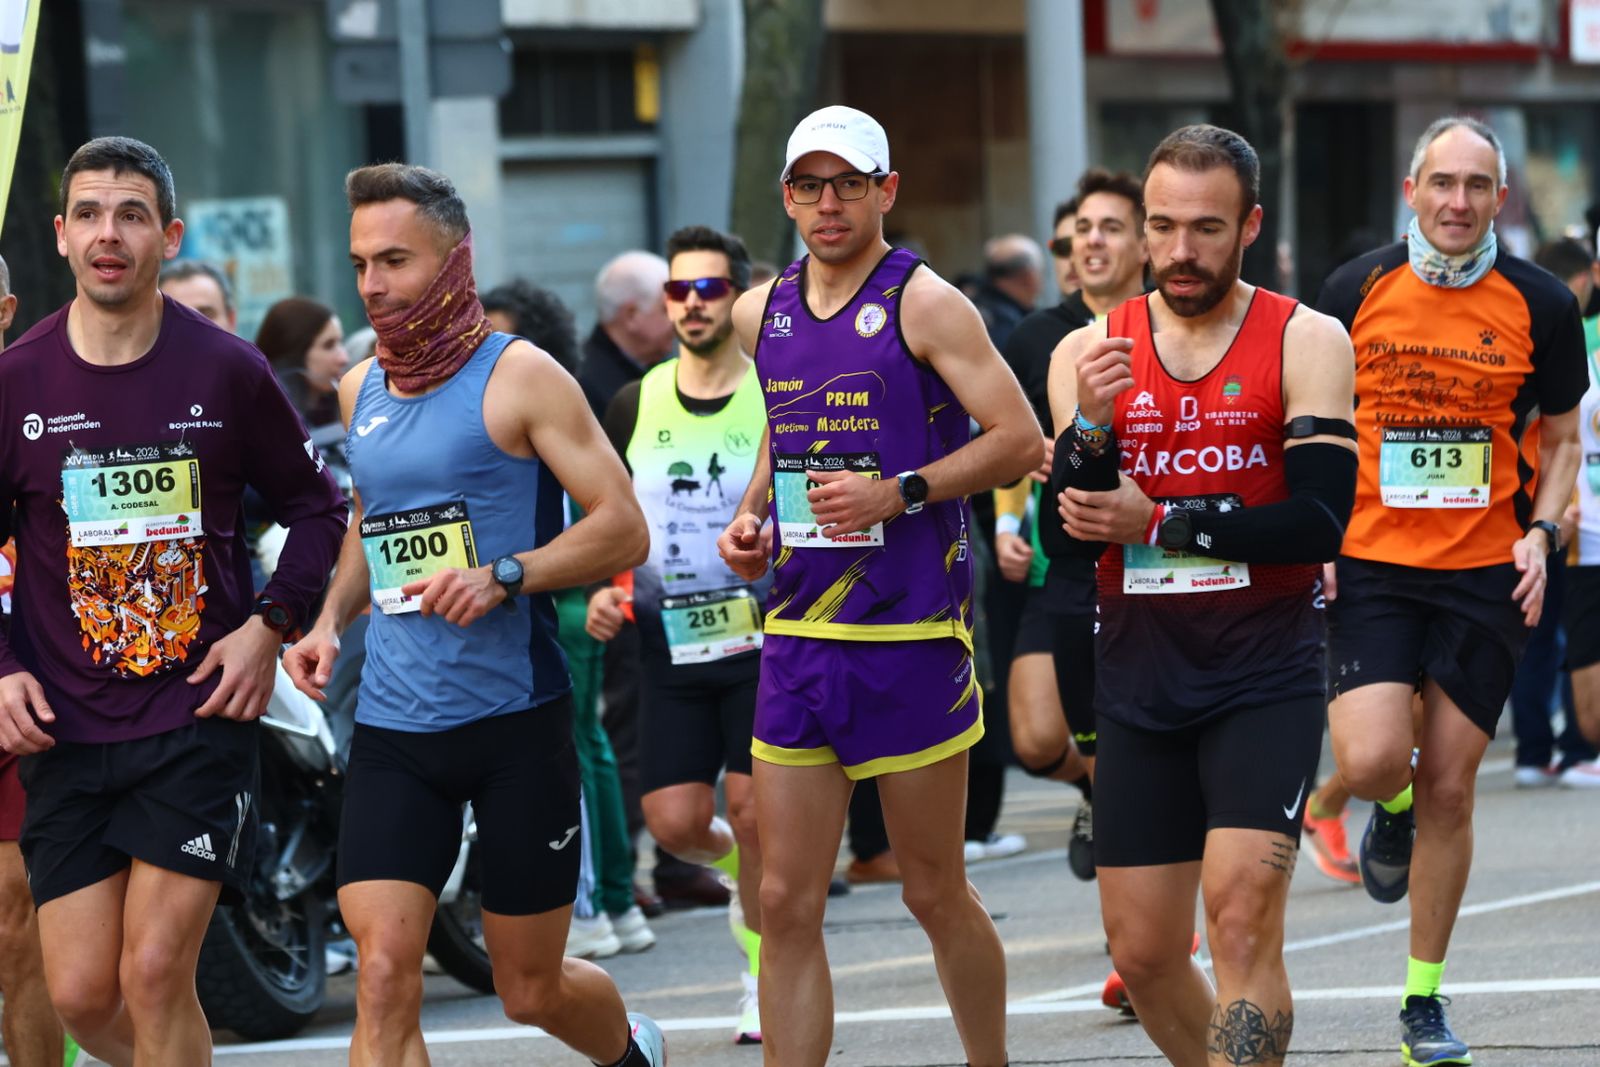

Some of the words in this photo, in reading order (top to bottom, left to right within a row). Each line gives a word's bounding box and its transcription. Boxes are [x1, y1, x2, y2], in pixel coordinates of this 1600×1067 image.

[1401, 344, 1428, 356] LOS
[1432, 345, 1506, 367] BERRACOS
[766, 377, 804, 393] Jamón
[826, 391, 869, 407] PRIM
[47, 412, 86, 425] nationale
[817, 416, 880, 432] Macotera
[47, 421, 101, 434] nederlanden
[169, 421, 223, 430] BOOMERANG
[1126, 423, 1163, 434] LOREDO
[1385, 431, 1398, 441] XIV
[1442, 429, 1463, 440] 2026
[135, 446, 160, 458] 2026
[1411, 447, 1463, 469] 613
[66, 455, 82, 466] XIV
[83, 453, 104, 462] MEDIA
[777, 459, 788, 469] XIV
[823, 457, 845, 467] 2026
[1120, 443, 1268, 477] CÁRCOBA
[91, 467, 176, 498] 1306
[121, 501, 159, 510] CODESAL
[1183, 499, 1207, 510] 2026
[409, 511, 431, 524] 2026
[79, 529, 114, 538] LABORAL
[146, 525, 189, 537] bedunia
[361, 522, 372, 534] XIV
[371, 521, 386, 529] MEDIA
[380, 531, 449, 565] 1200
[406, 568, 423, 576] BENI
[1130, 577, 1159, 585] LABORAL
[1191, 576, 1236, 587] bedunia
[687, 605, 730, 630] 281
[181, 844, 217, 861] adidas
